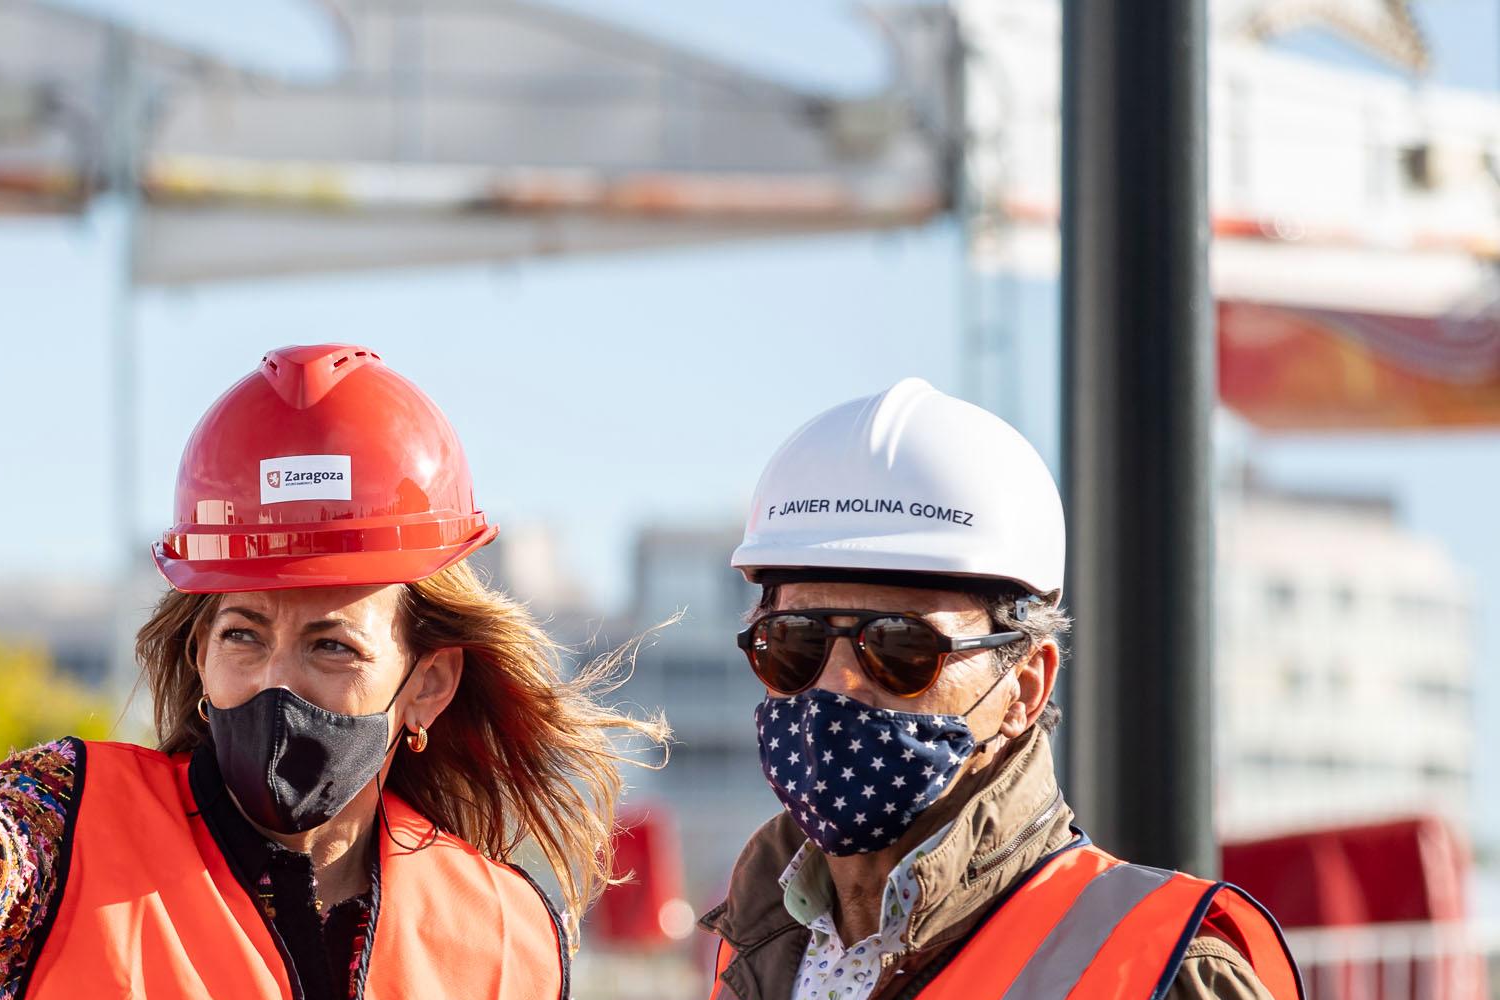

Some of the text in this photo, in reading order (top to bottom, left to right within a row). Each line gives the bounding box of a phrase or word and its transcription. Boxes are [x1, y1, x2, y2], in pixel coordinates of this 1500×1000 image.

[284, 470, 344, 484] Zaragoza
[768, 498, 974, 527] F JAVIER MOLINA GOMEZ
